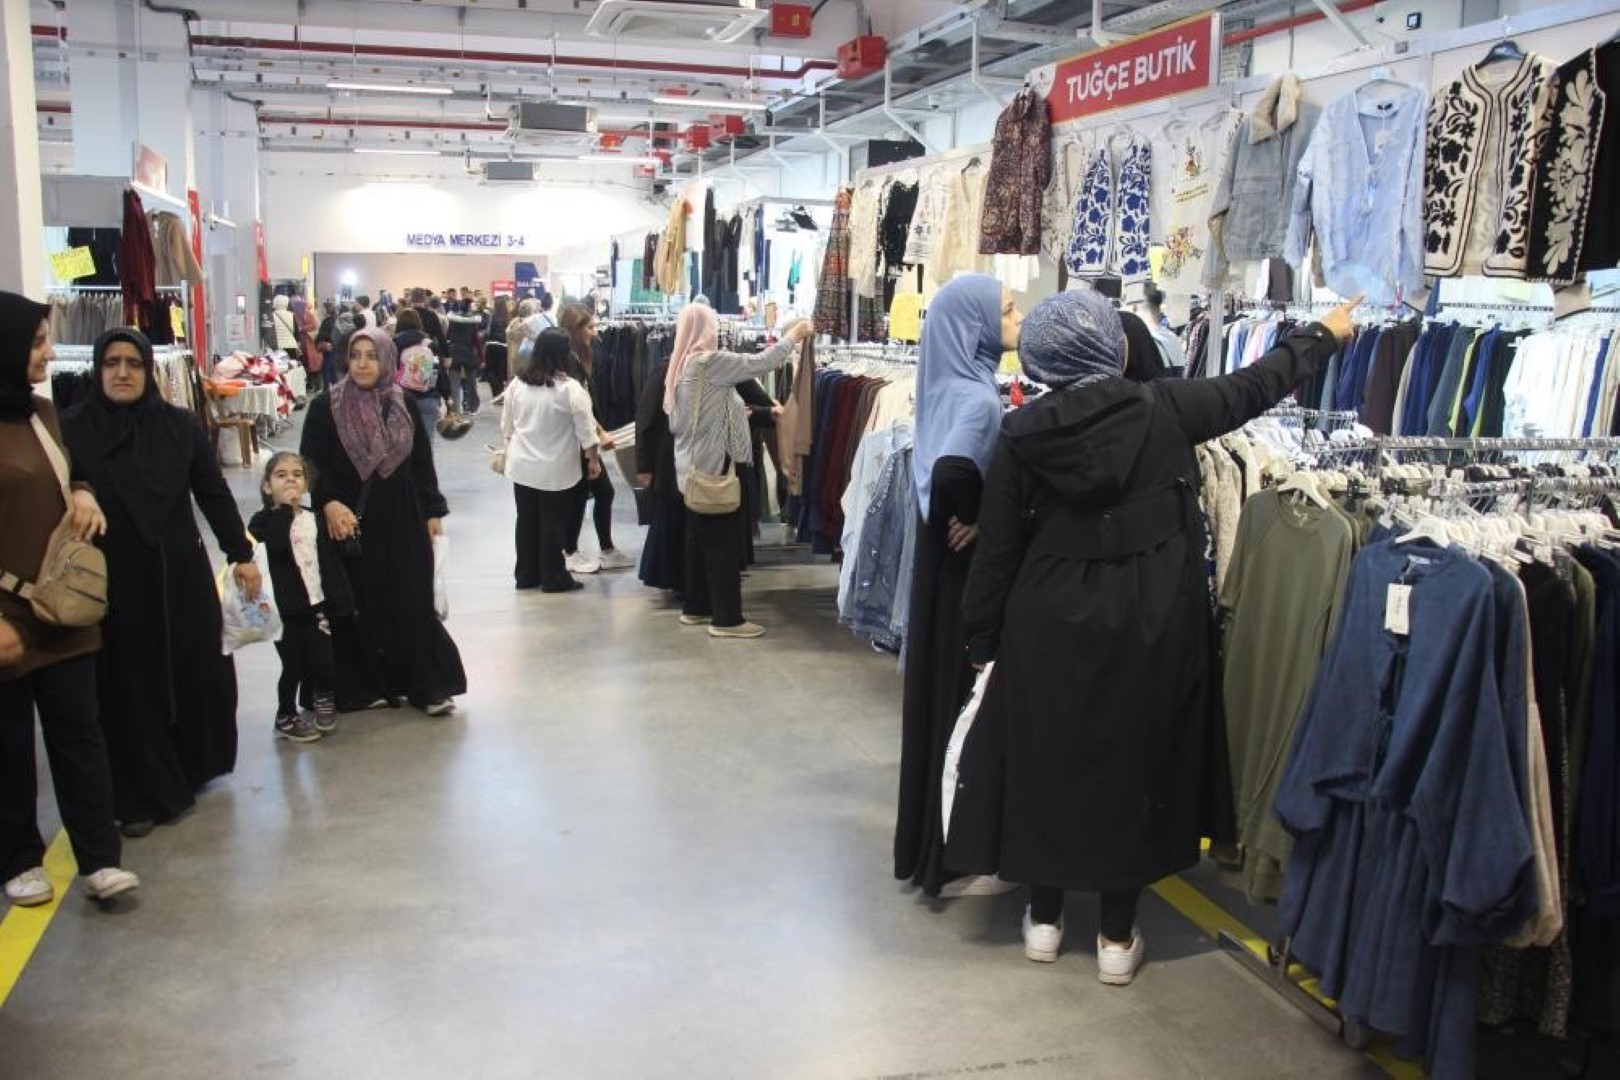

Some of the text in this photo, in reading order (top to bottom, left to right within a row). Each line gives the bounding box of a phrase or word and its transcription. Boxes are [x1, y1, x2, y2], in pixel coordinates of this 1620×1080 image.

[1066, 36, 1196, 104] TUĞÇE BUTİK
[406, 233, 446, 246] MEDYA
[507, 235, 524, 247] 3-4
